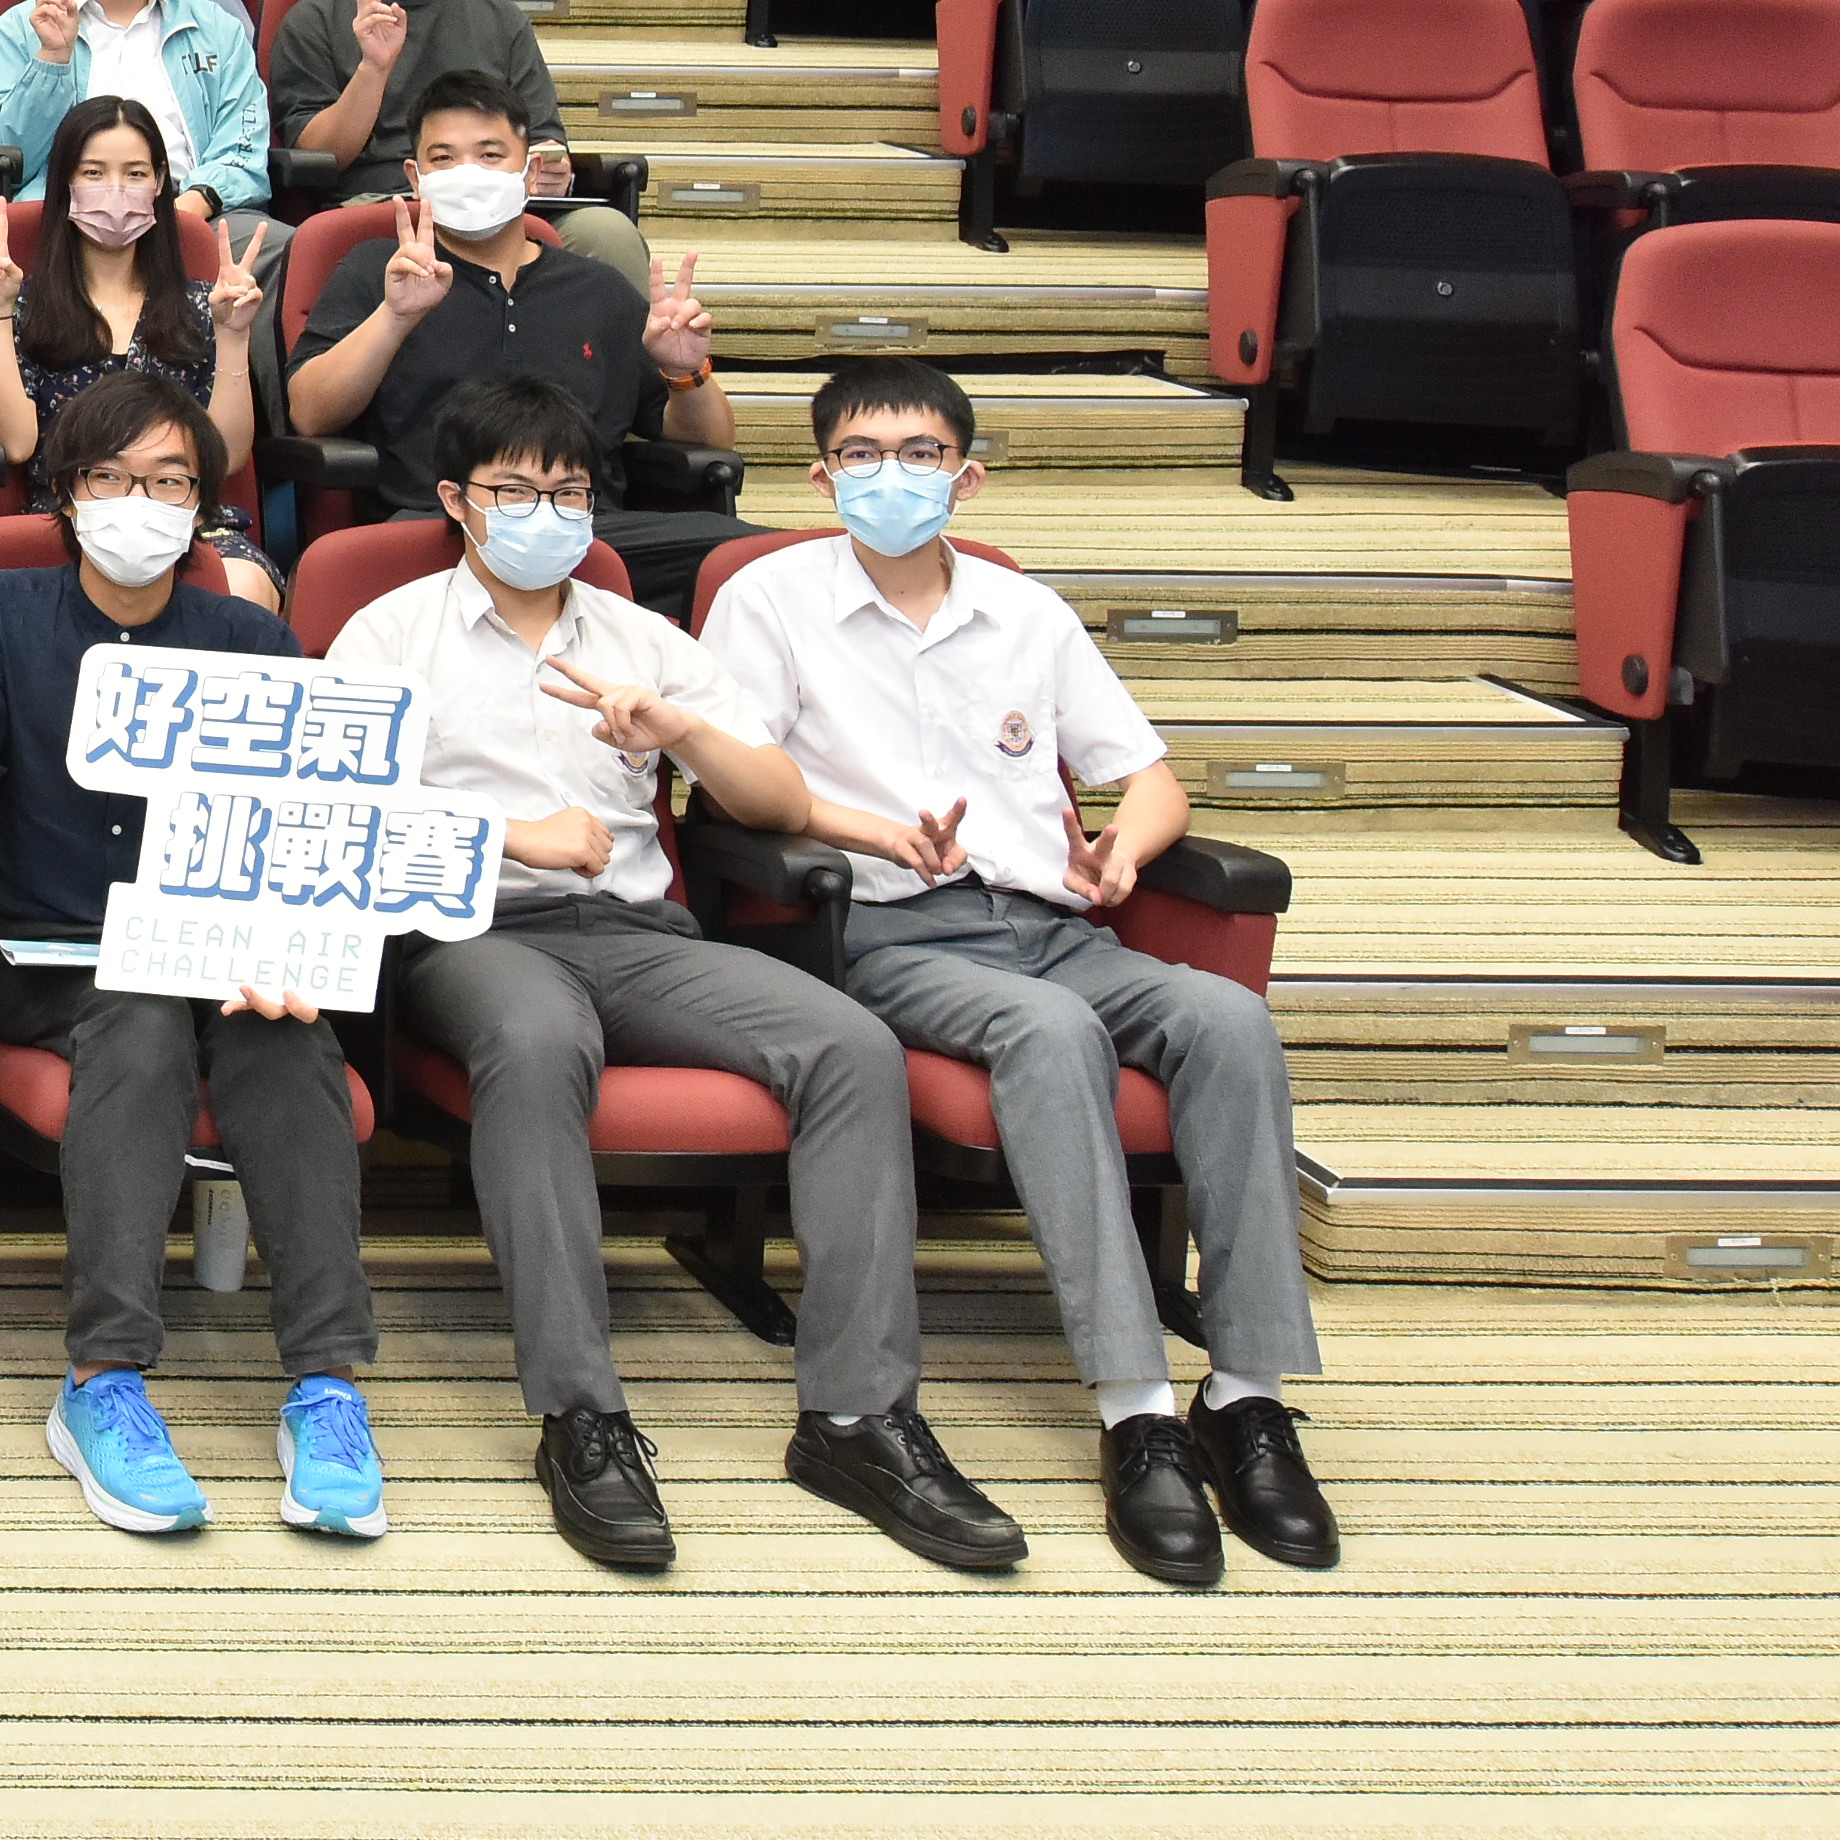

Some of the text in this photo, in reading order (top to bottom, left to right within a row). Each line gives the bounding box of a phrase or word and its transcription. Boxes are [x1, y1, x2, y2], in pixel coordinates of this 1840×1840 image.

[86, 662, 412, 786] 好空氣
[159, 791, 488, 919] 挑戰賽
[121, 948, 357, 993] CHALLENGE
[125, 916, 361, 959] CLEAN AIR
